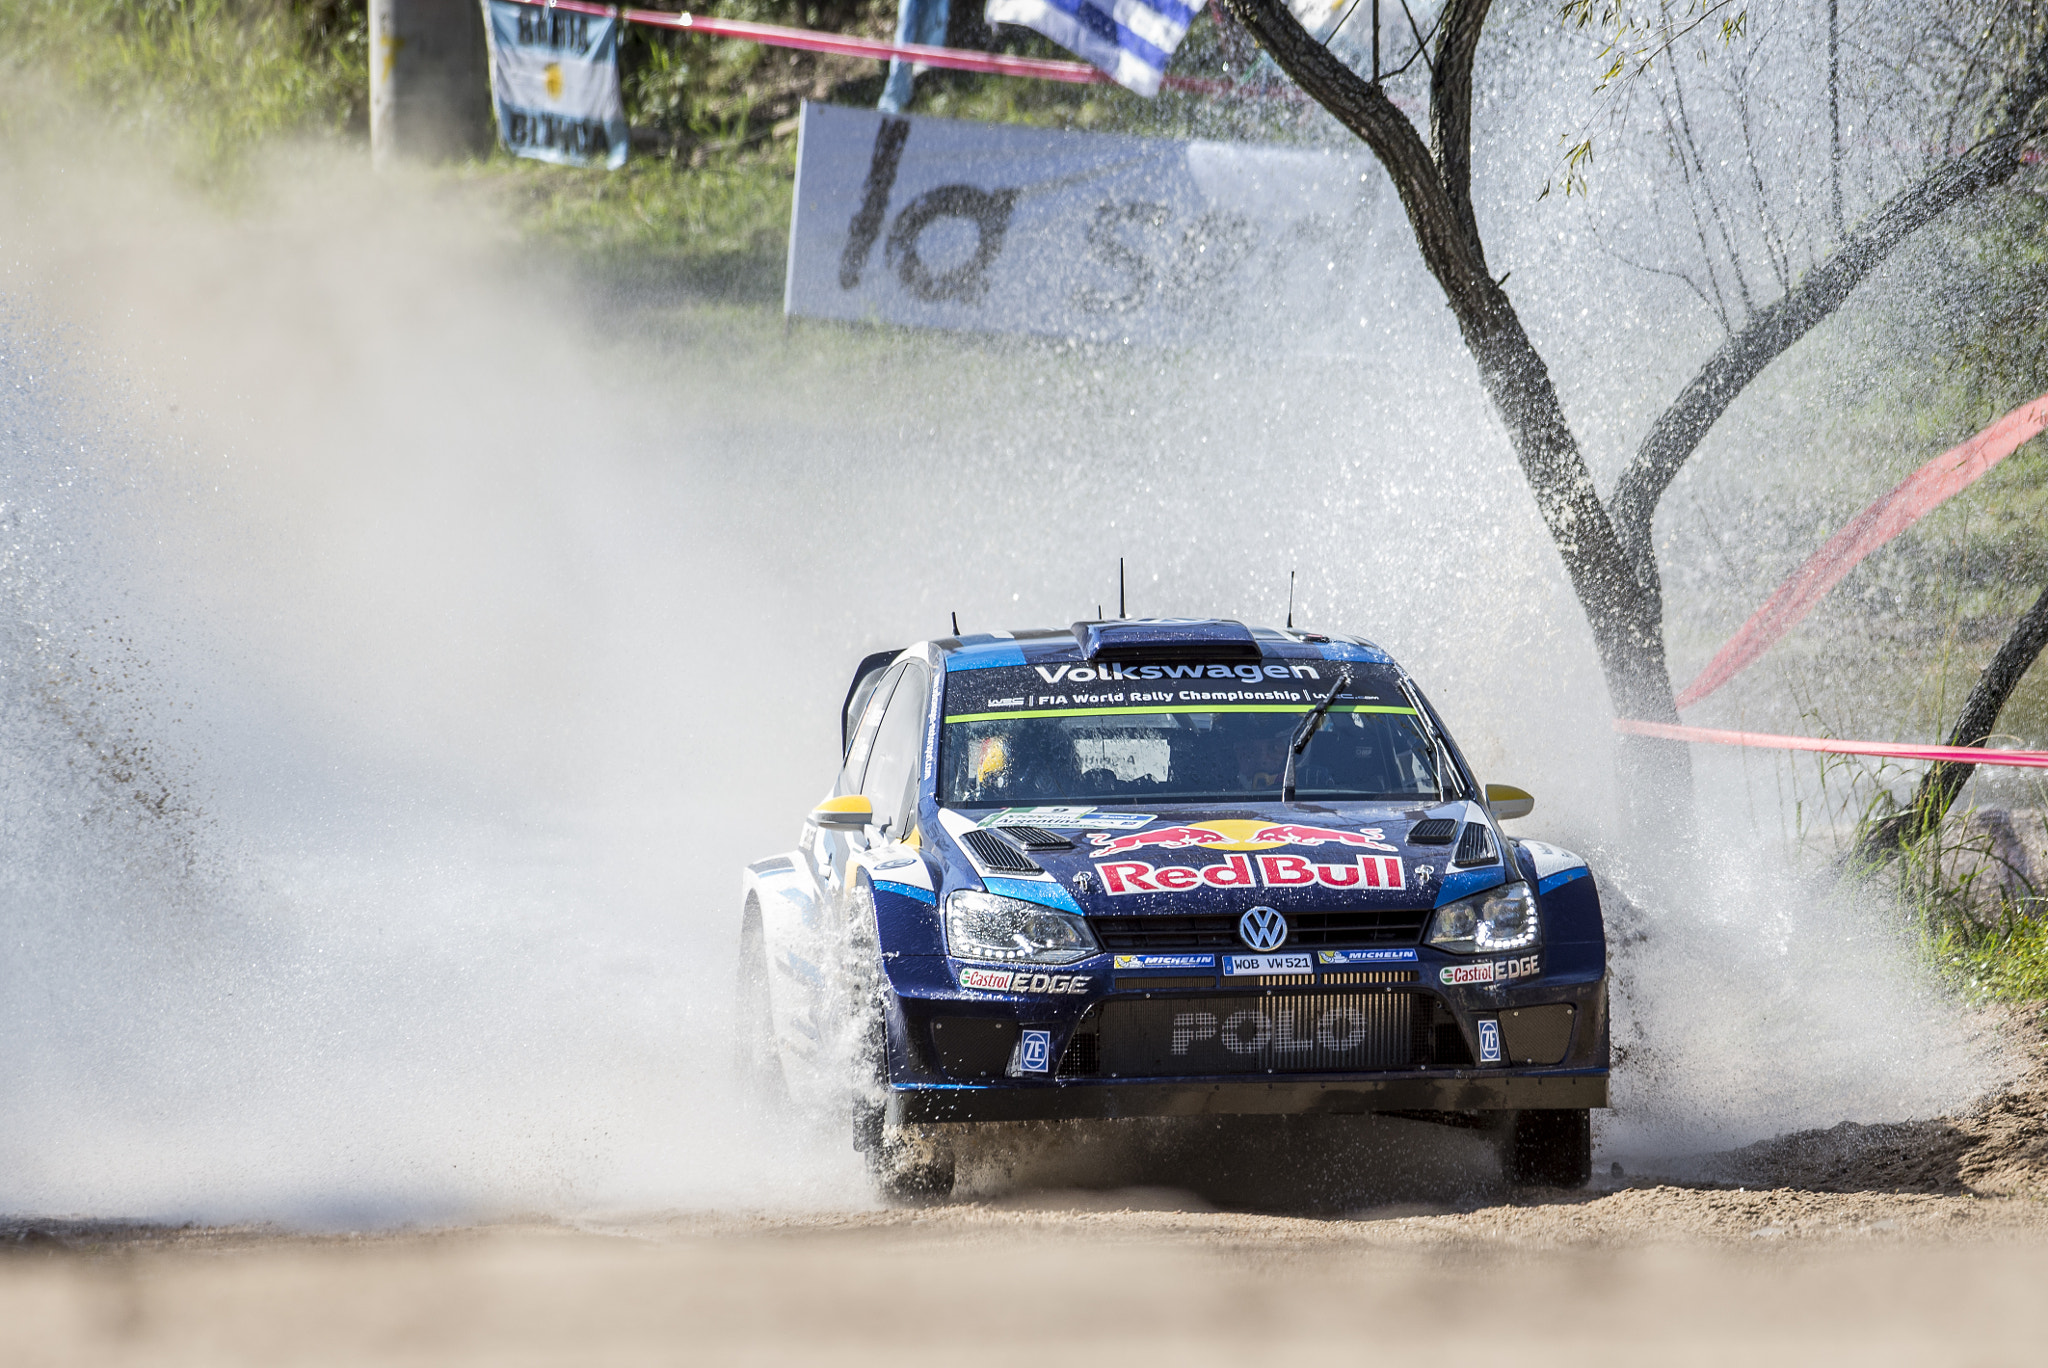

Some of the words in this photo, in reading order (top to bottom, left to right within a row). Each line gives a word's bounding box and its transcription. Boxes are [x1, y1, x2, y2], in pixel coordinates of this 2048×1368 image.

[838, 116, 1018, 304] la
[1034, 662, 1320, 684] Volkswagen
[1038, 695, 1068, 705] FIA
[1072, 692, 1124, 704] World
[1130, 691, 1174, 703] Rally
[1178, 690, 1300, 701] Championship
[1097, 853, 1255, 895] Red
[1257, 854, 1404, 889] Bull
[1144, 955, 1213, 965] MICHELIN
[1234, 956, 1260, 969] WOB
[1268, 957, 1283, 969] VW
[1285, 956, 1310, 969] 521
[1348, 950, 1414, 959] MICHELIN
[1453, 965, 1492, 982] Castrol
[1494, 954, 1539, 981] EDGE
[969, 970, 1011, 989] Castrol
[1011, 973, 1093, 995] EDGE
[1171, 1007, 1368, 1055] POLO
[1483, 1030, 1499, 1051] ZF
[1024, 1041, 1044, 1061] ZF
